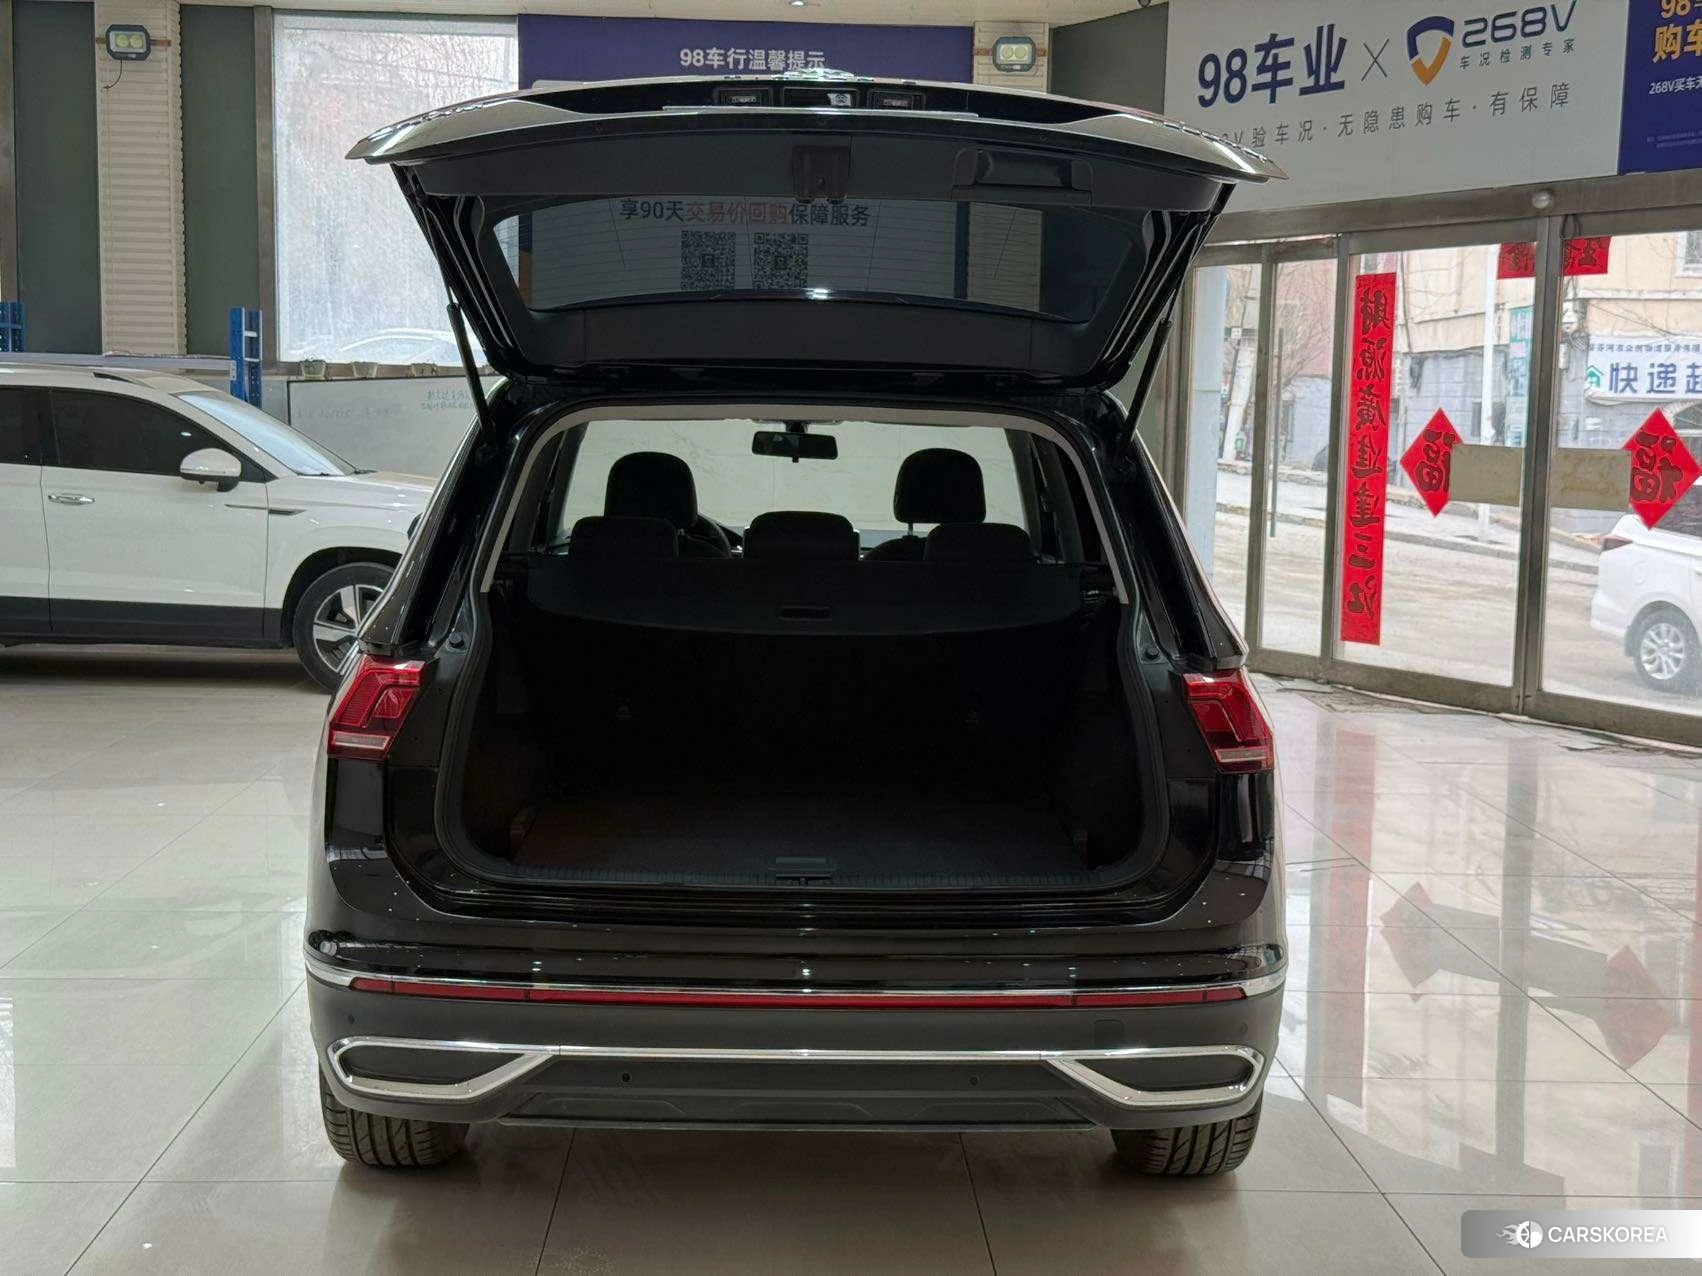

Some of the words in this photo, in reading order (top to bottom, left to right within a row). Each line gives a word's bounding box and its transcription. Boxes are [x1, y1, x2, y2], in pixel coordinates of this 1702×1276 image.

[1461, 0, 1578, 48] 268V
[679, 47, 827, 71] 98车行温馨提示
[1197, 23, 1348, 108] 98车业
[1458, 38, 1576, 71] 车况检测专家
[618, 199, 871, 227] 享90天交易价回购保障服务
